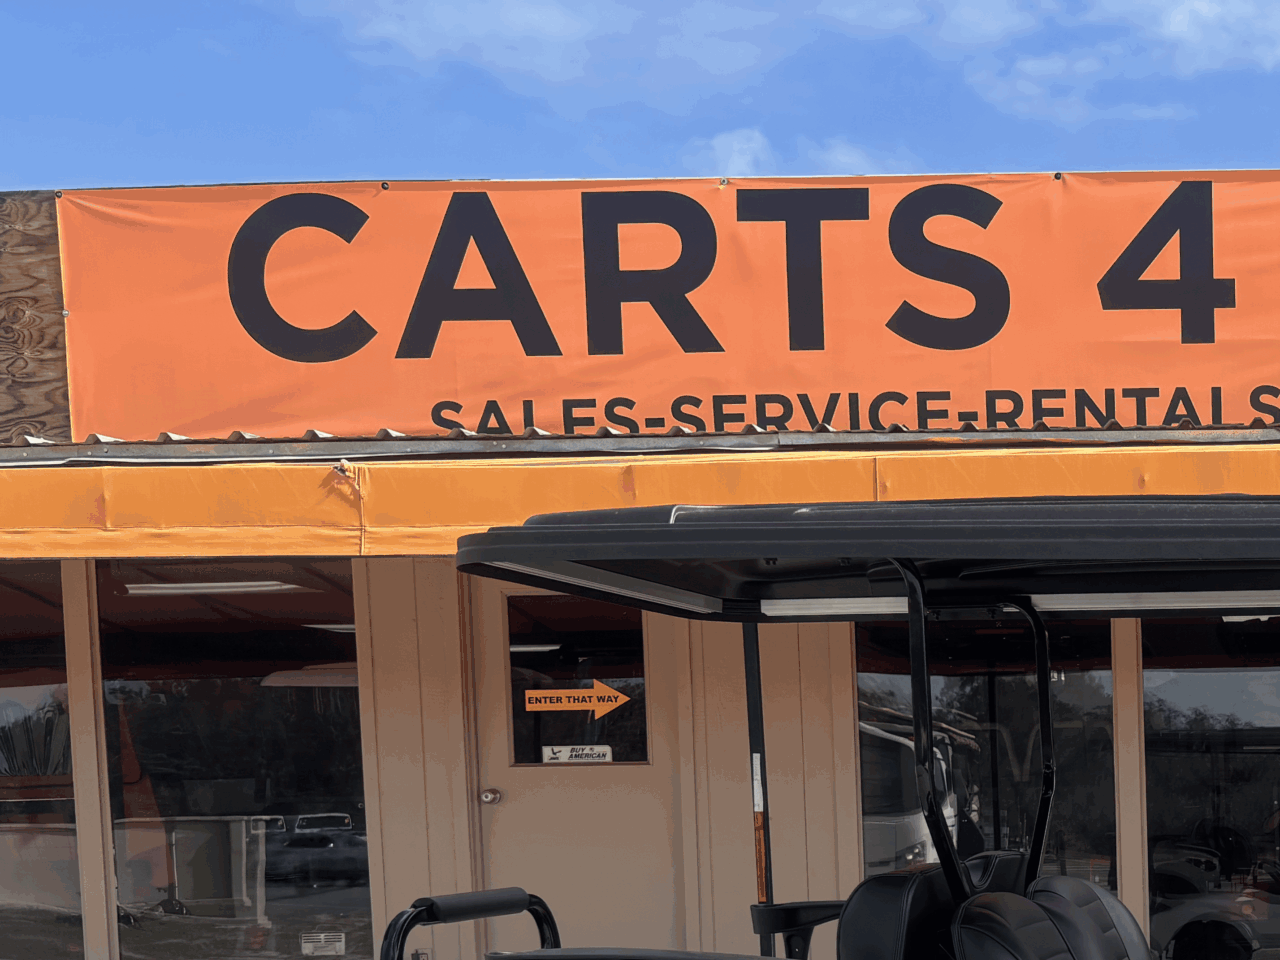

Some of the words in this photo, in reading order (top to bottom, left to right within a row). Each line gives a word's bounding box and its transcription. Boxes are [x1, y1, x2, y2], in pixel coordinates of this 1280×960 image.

[227, 183, 1011, 363] CARTS
[1096, 180, 1236, 344] 4
[528, 696, 563, 704] ENTER
[565, 695, 594, 704] THAT
[596, 695, 620, 703] WAY
